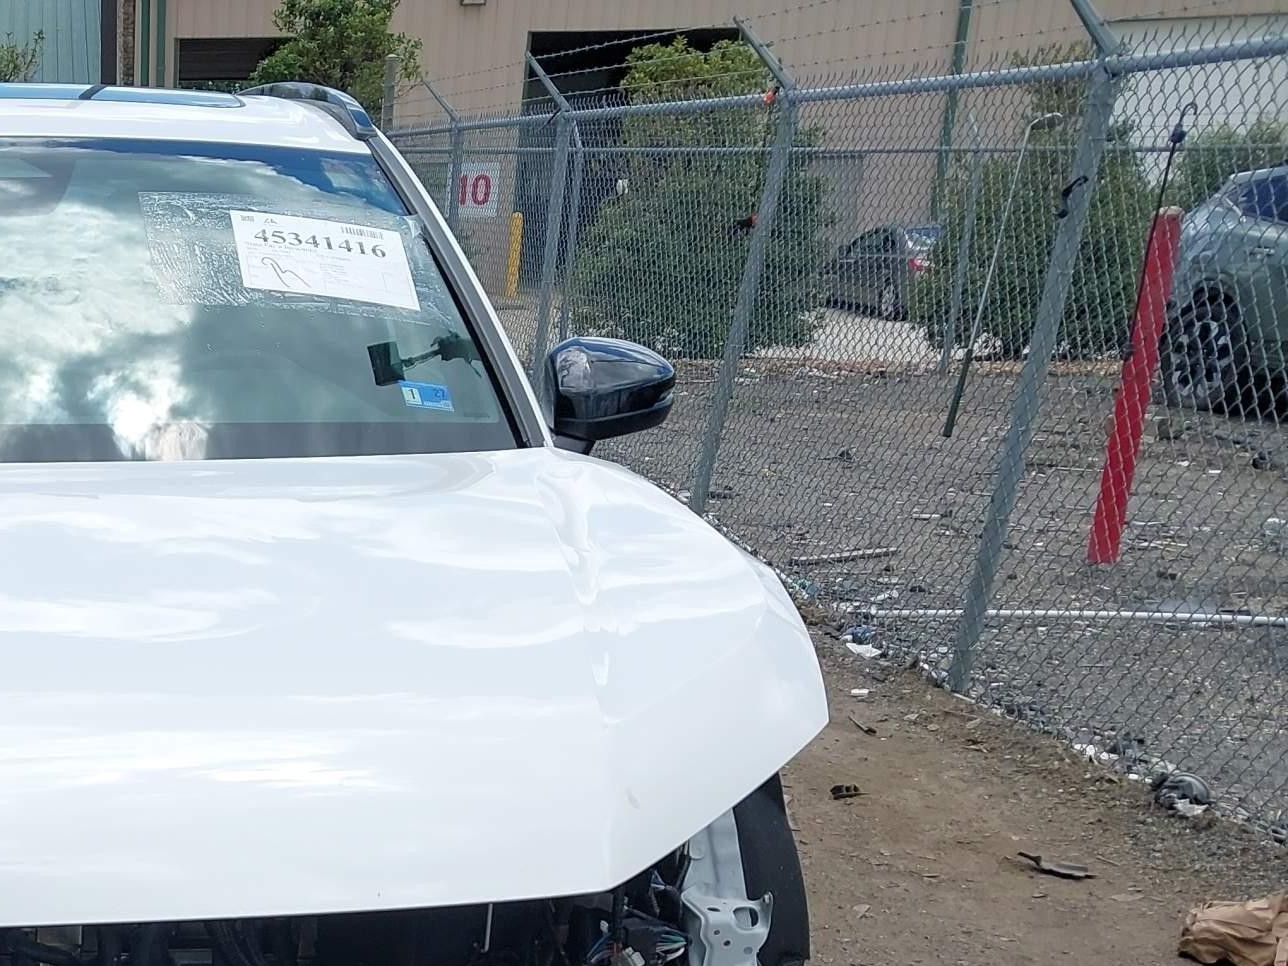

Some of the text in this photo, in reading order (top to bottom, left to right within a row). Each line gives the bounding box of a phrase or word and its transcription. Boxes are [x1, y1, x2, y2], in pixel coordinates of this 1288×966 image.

[459, 174, 491, 206] 10
[254, 228, 387, 259] 45341416
[408, 388, 416, 400] 1
